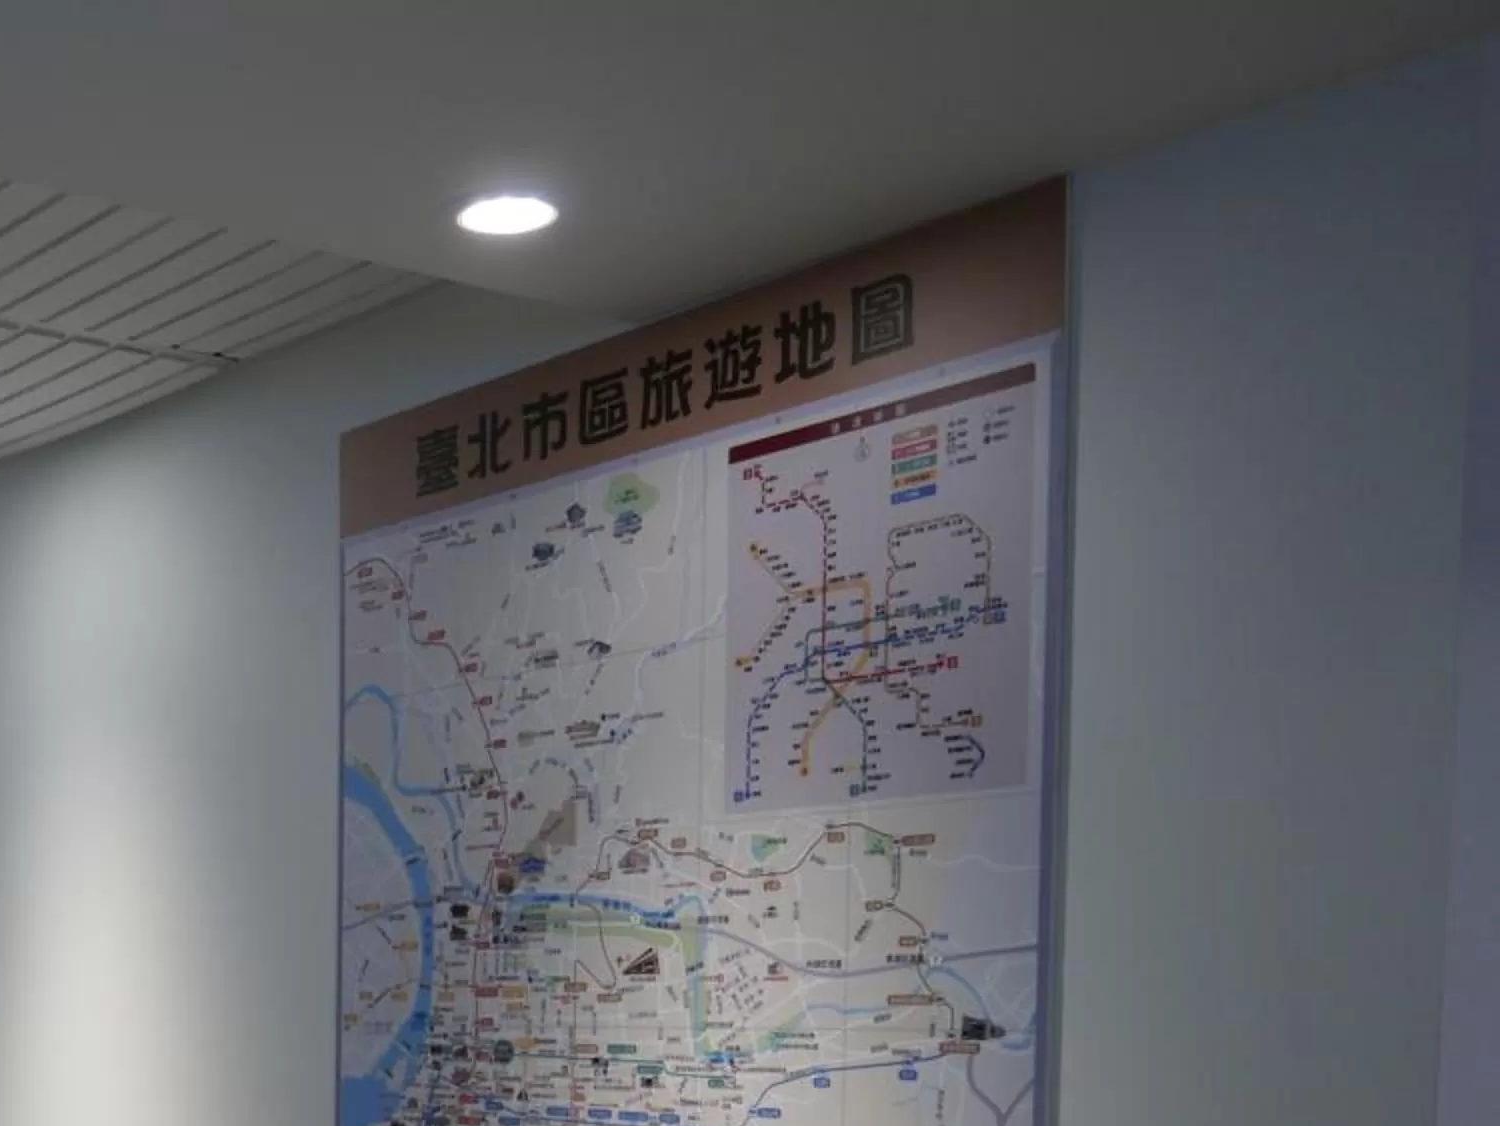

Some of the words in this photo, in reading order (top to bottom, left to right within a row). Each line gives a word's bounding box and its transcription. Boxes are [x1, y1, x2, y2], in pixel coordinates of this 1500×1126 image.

[415, 273, 914, 496] 臺北市區旅遊地圖
